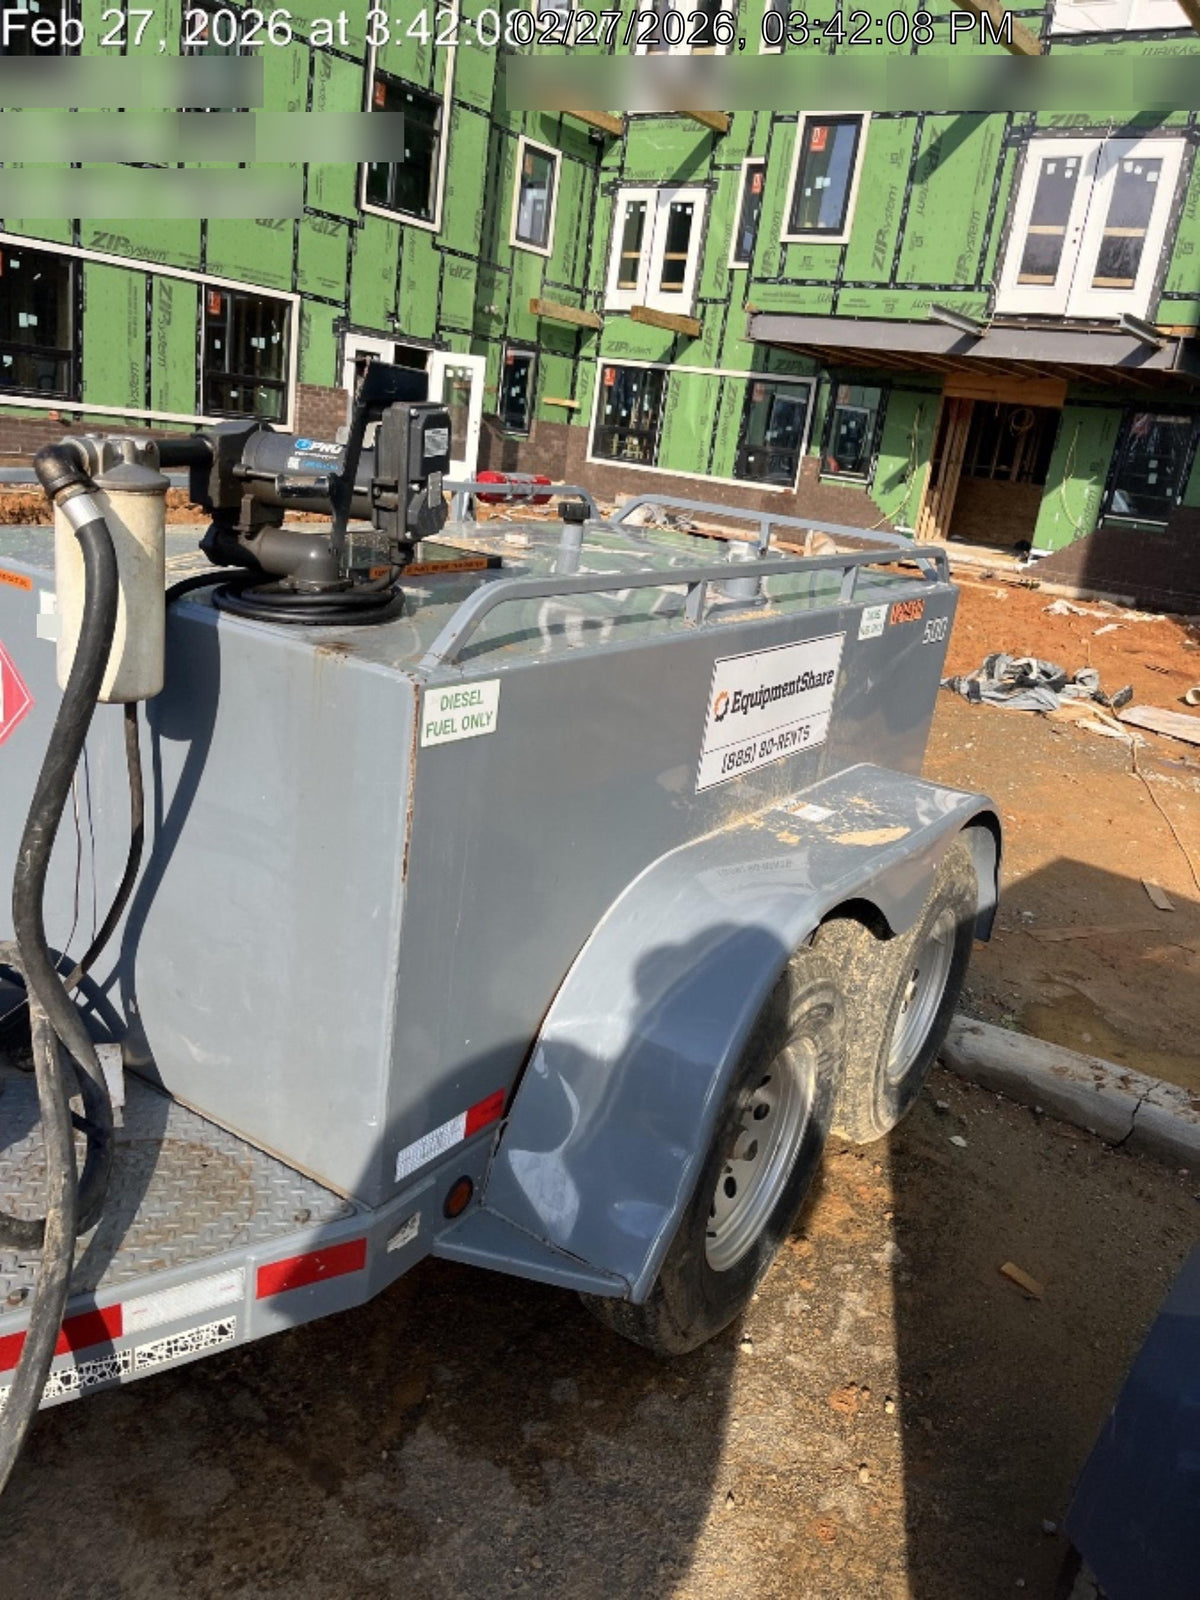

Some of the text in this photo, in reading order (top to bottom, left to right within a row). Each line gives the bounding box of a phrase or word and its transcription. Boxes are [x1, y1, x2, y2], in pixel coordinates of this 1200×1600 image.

[440, 689, 484, 712] DIESEL
[730, 669, 835, 715] EquipmentShare
[426, 710, 493, 738] FUEL ONLY
